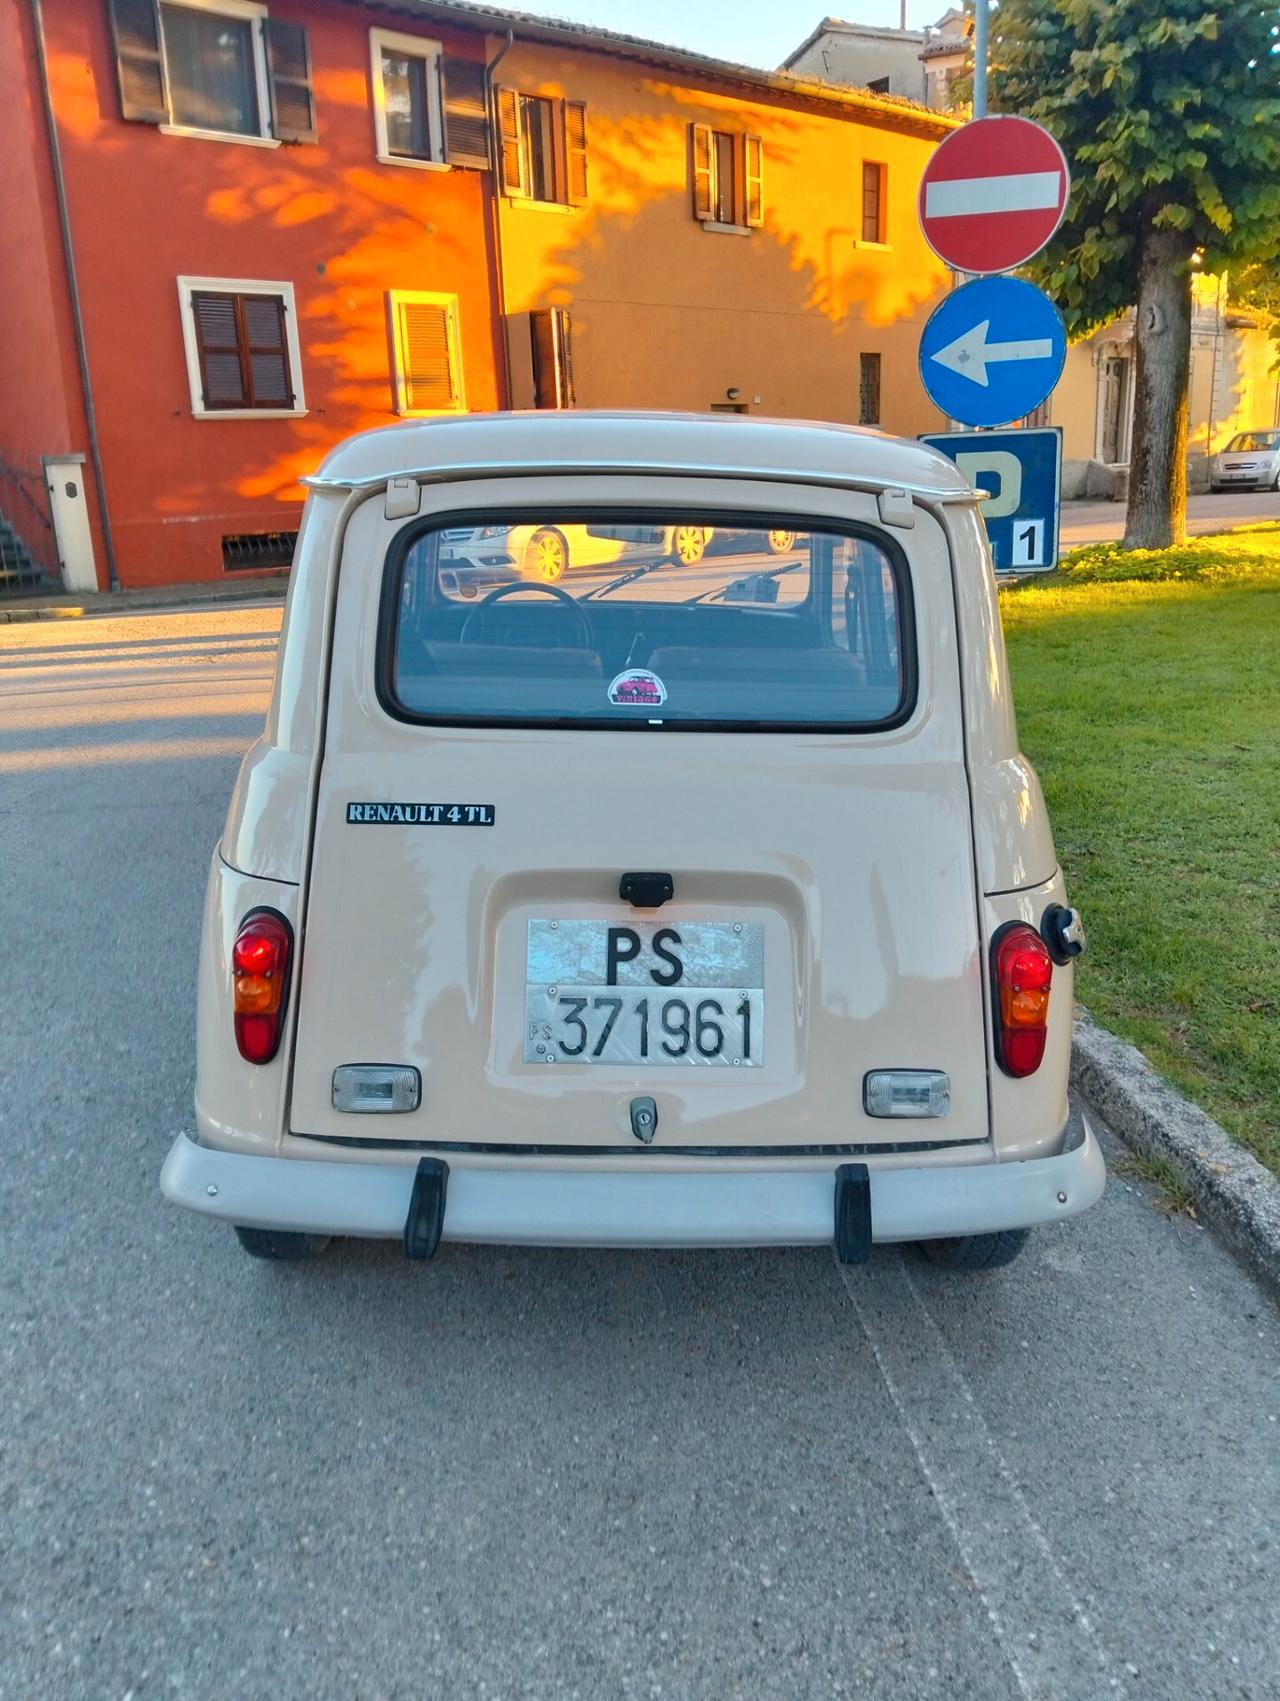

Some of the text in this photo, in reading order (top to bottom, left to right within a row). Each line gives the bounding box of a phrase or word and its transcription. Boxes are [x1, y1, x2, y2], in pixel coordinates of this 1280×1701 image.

[956, 451, 1022, 517] P
[1020, 526, 1035, 560] 1
[349, 805, 491, 823] RENAULT 4 TL
[607, 928, 684, 986] PS
[558, 998, 751, 1058] 371961
